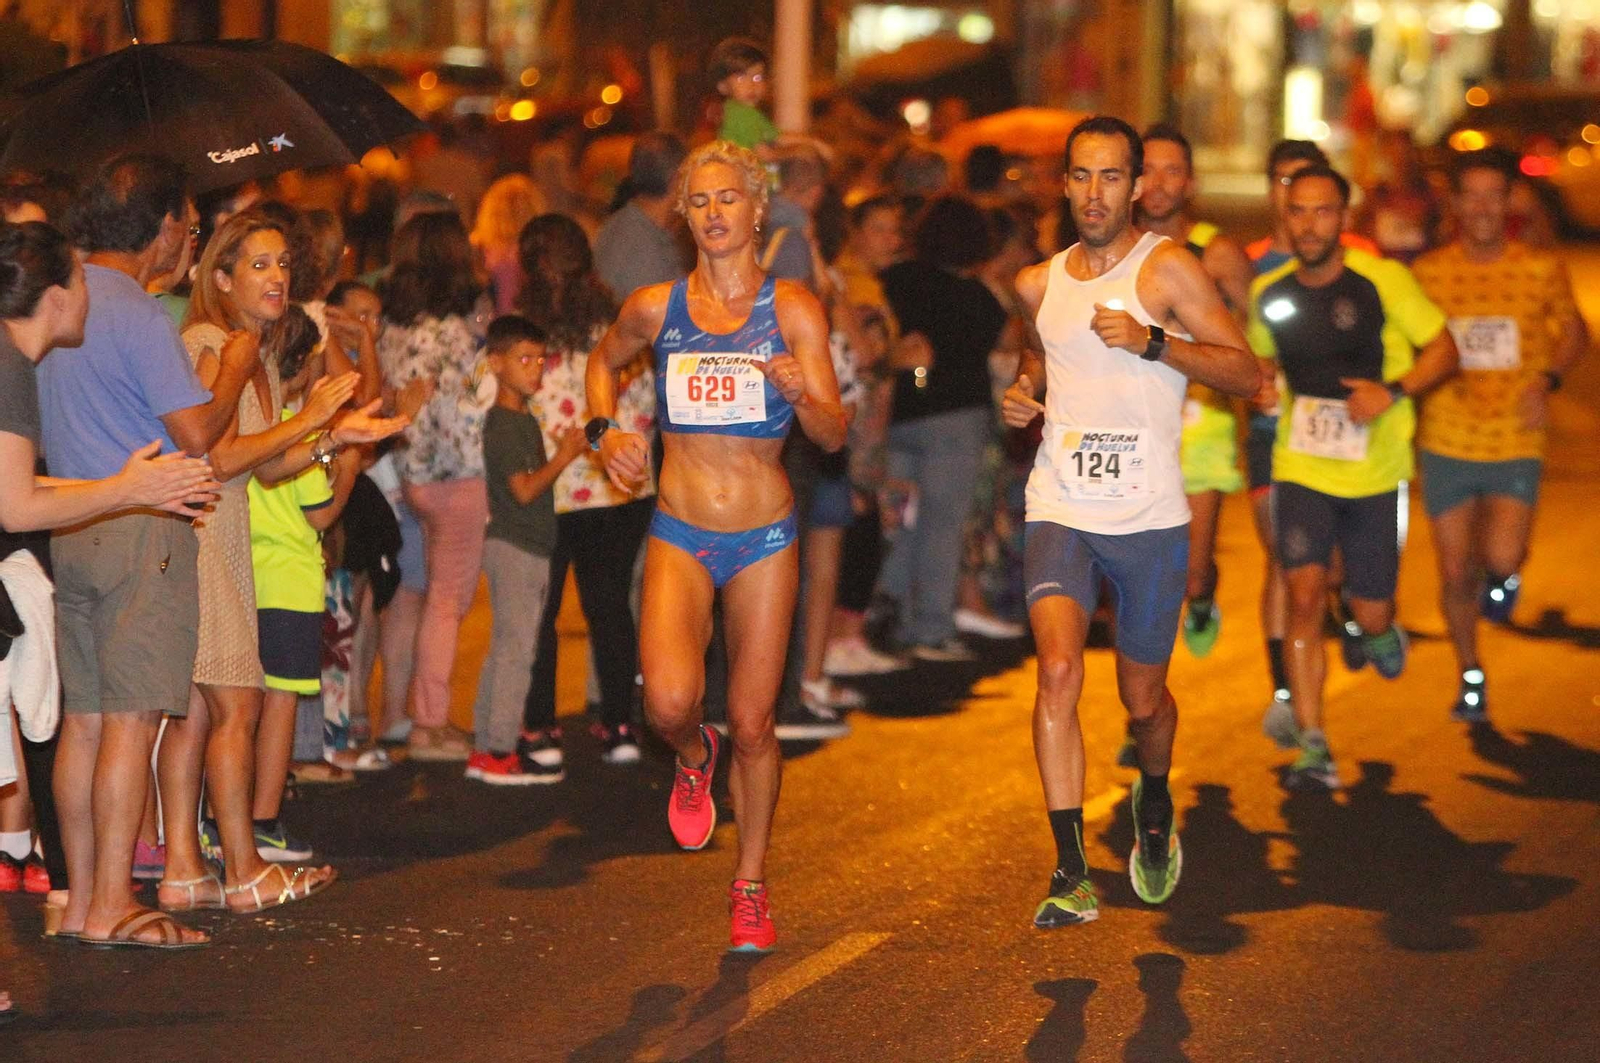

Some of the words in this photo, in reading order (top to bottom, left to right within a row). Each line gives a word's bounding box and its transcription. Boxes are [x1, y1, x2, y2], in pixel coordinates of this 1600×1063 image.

[206, 142, 260, 164] Cajasol
[695, 366, 709, 375] DE
[711, 365, 751, 375] HUELVA
[687, 375, 736, 402] 629
[1081, 432, 1139, 443] NOCTURNA
[1079, 442, 1094, 451] DE
[1096, 442, 1137, 452] HUELVA
[1070, 451, 1121, 479] 124
